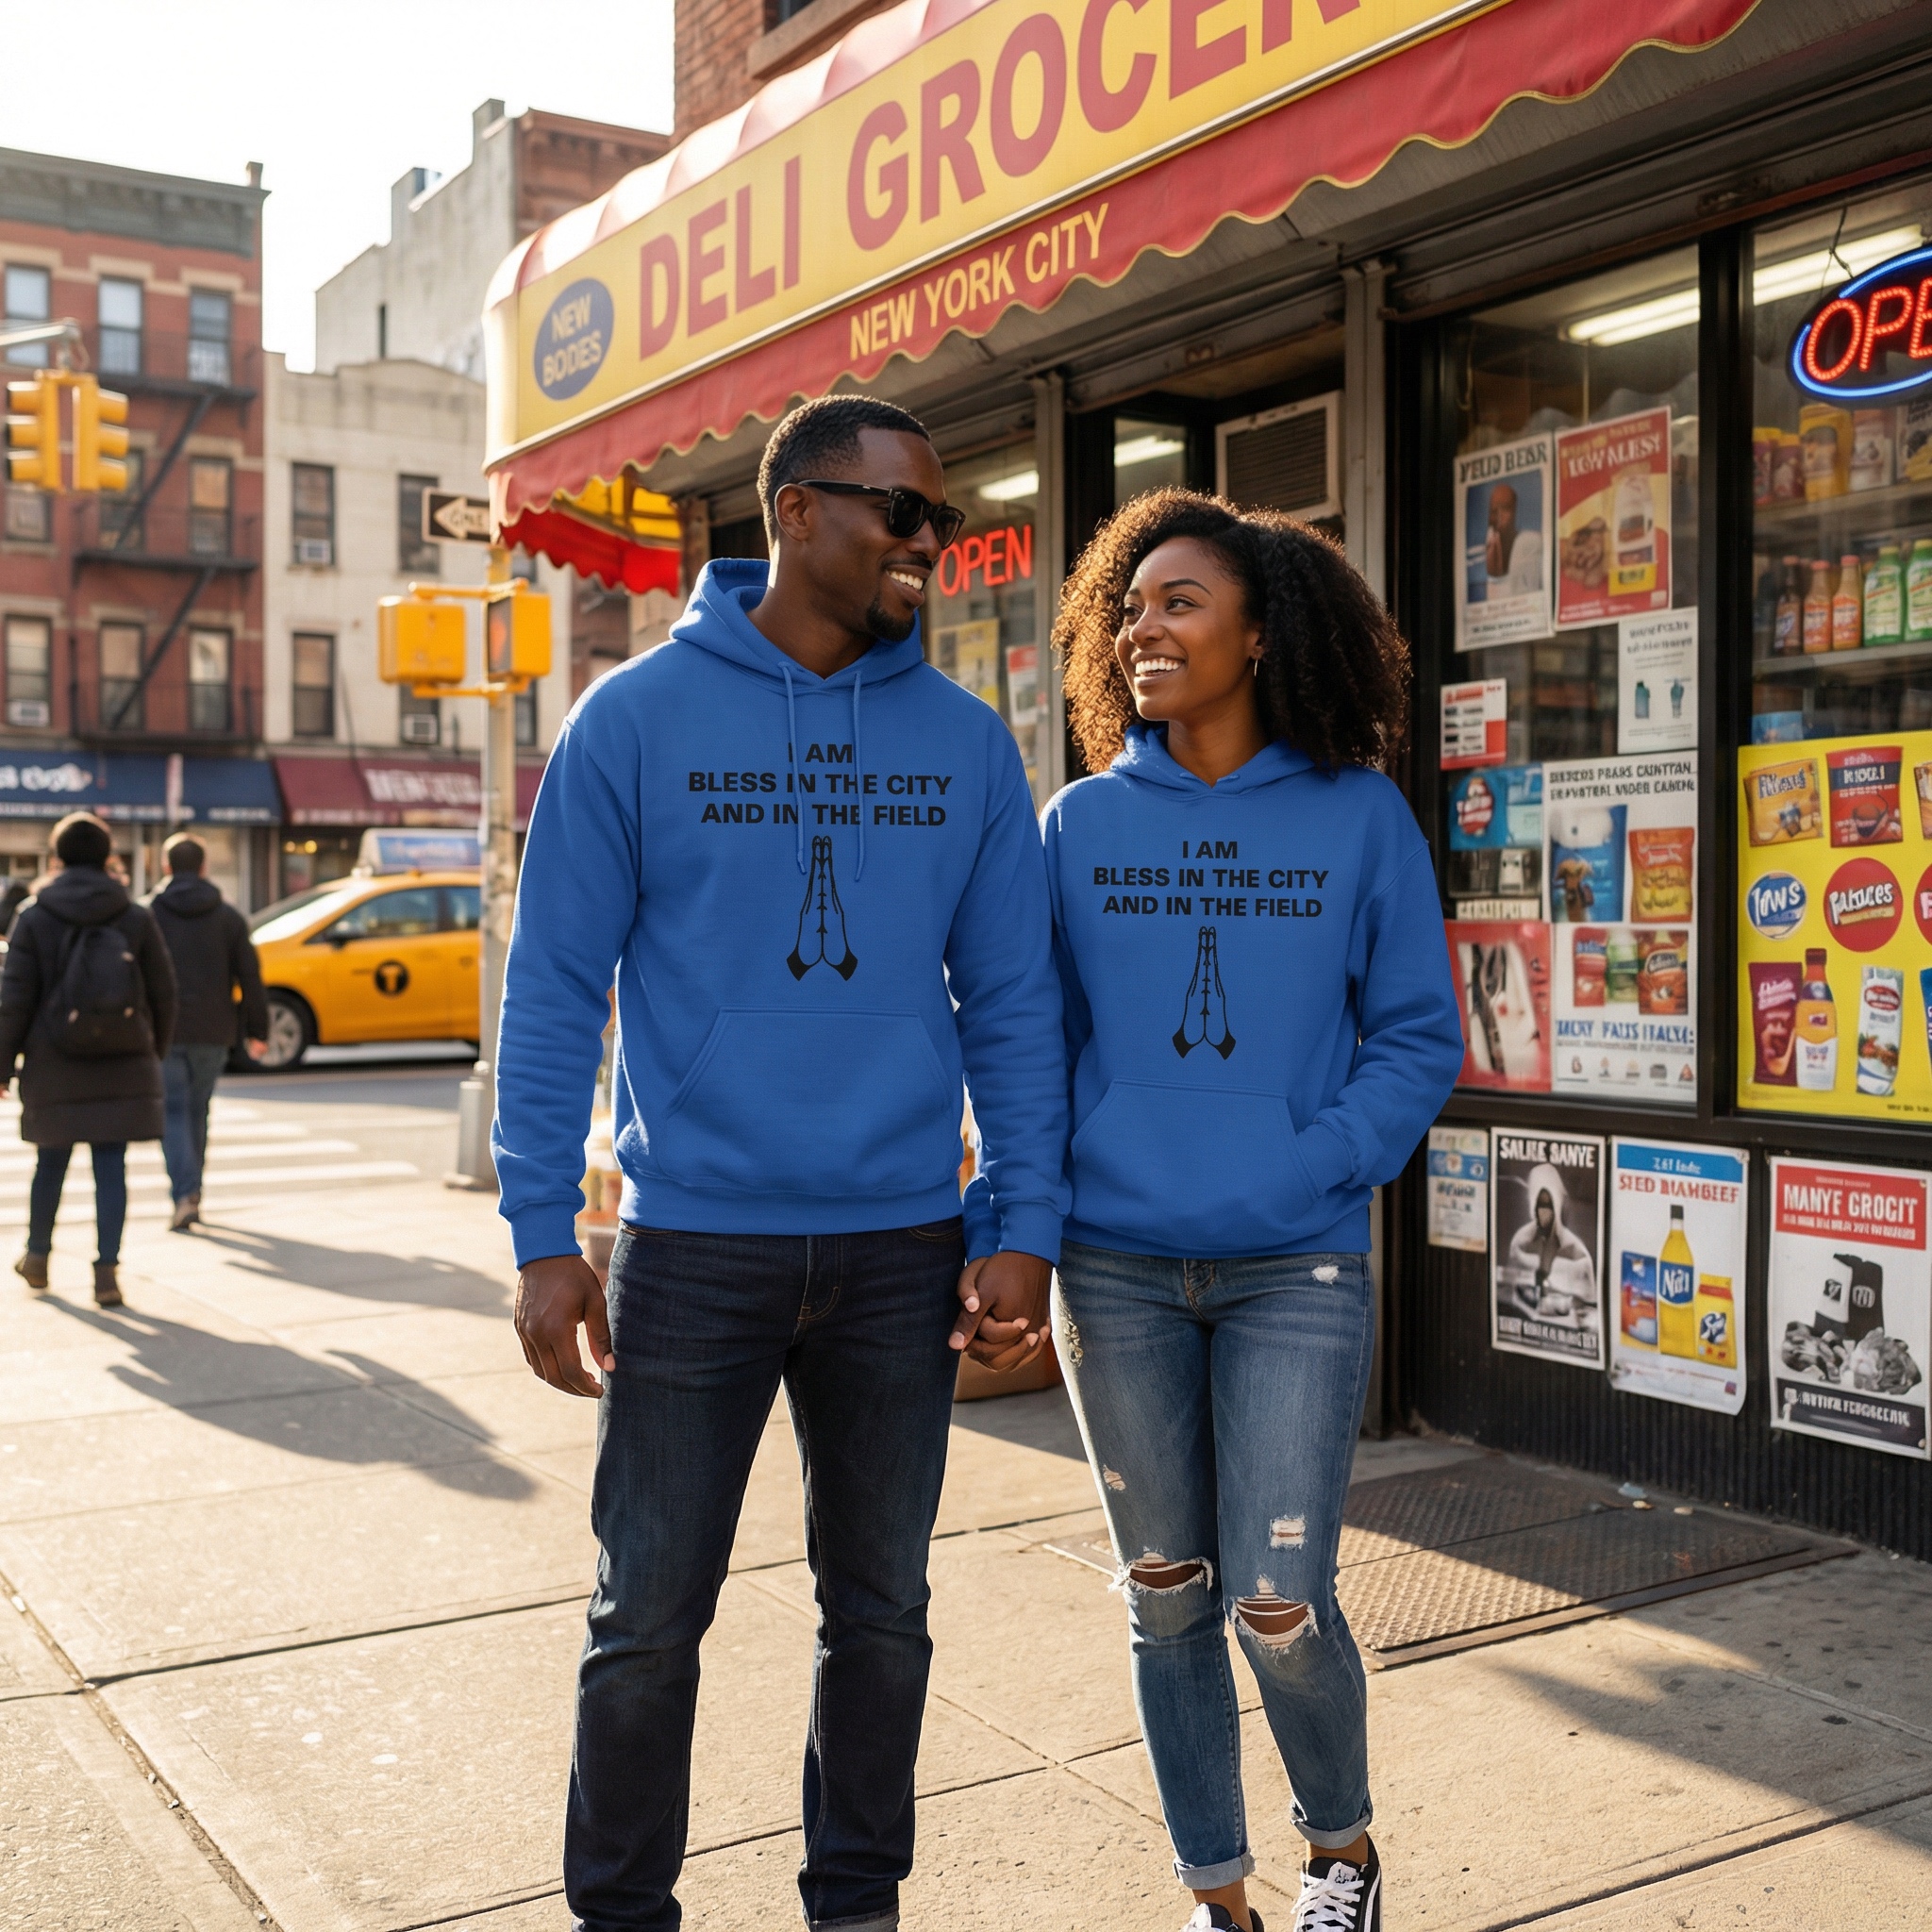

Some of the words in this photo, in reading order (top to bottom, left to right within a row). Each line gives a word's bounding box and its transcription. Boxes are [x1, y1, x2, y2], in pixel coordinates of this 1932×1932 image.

[640, 155, 800, 362] DELI
[851, 288, 917, 361] NEW
[924, 244, 1016, 327] YORK
[1024, 202, 1109, 283] CITY
[551, 293, 591, 342] NEW
[938, 525, 1031, 597] OPEN
[805, 743, 853, 763] AM
[689, 773, 777, 793] BLESS
[787, 774, 816, 793] IN
[824, 774, 877, 794] THE
[886, 774, 953, 795] CITY
[701, 804, 765, 824] AND
[773, 804, 799, 824] IN
[811, 804, 861, 825] THE
[874, 805, 947, 826] FIELD
[1182, 841, 1189, 858] I
[1194, 841, 1238, 859] AM
[1093, 867, 1171, 887] BLESS
[1178, 869, 1204, 887] IN
[1212, 869, 1260, 889] THE
[1268, 870, 1330, 889] CITY
[1102, 895, 1159, 915] AND
[1166, 896, 1191, 915] IN
[1200, 897, 1247, 917] THE
[1255, 898, 1323, 918] FIELD
